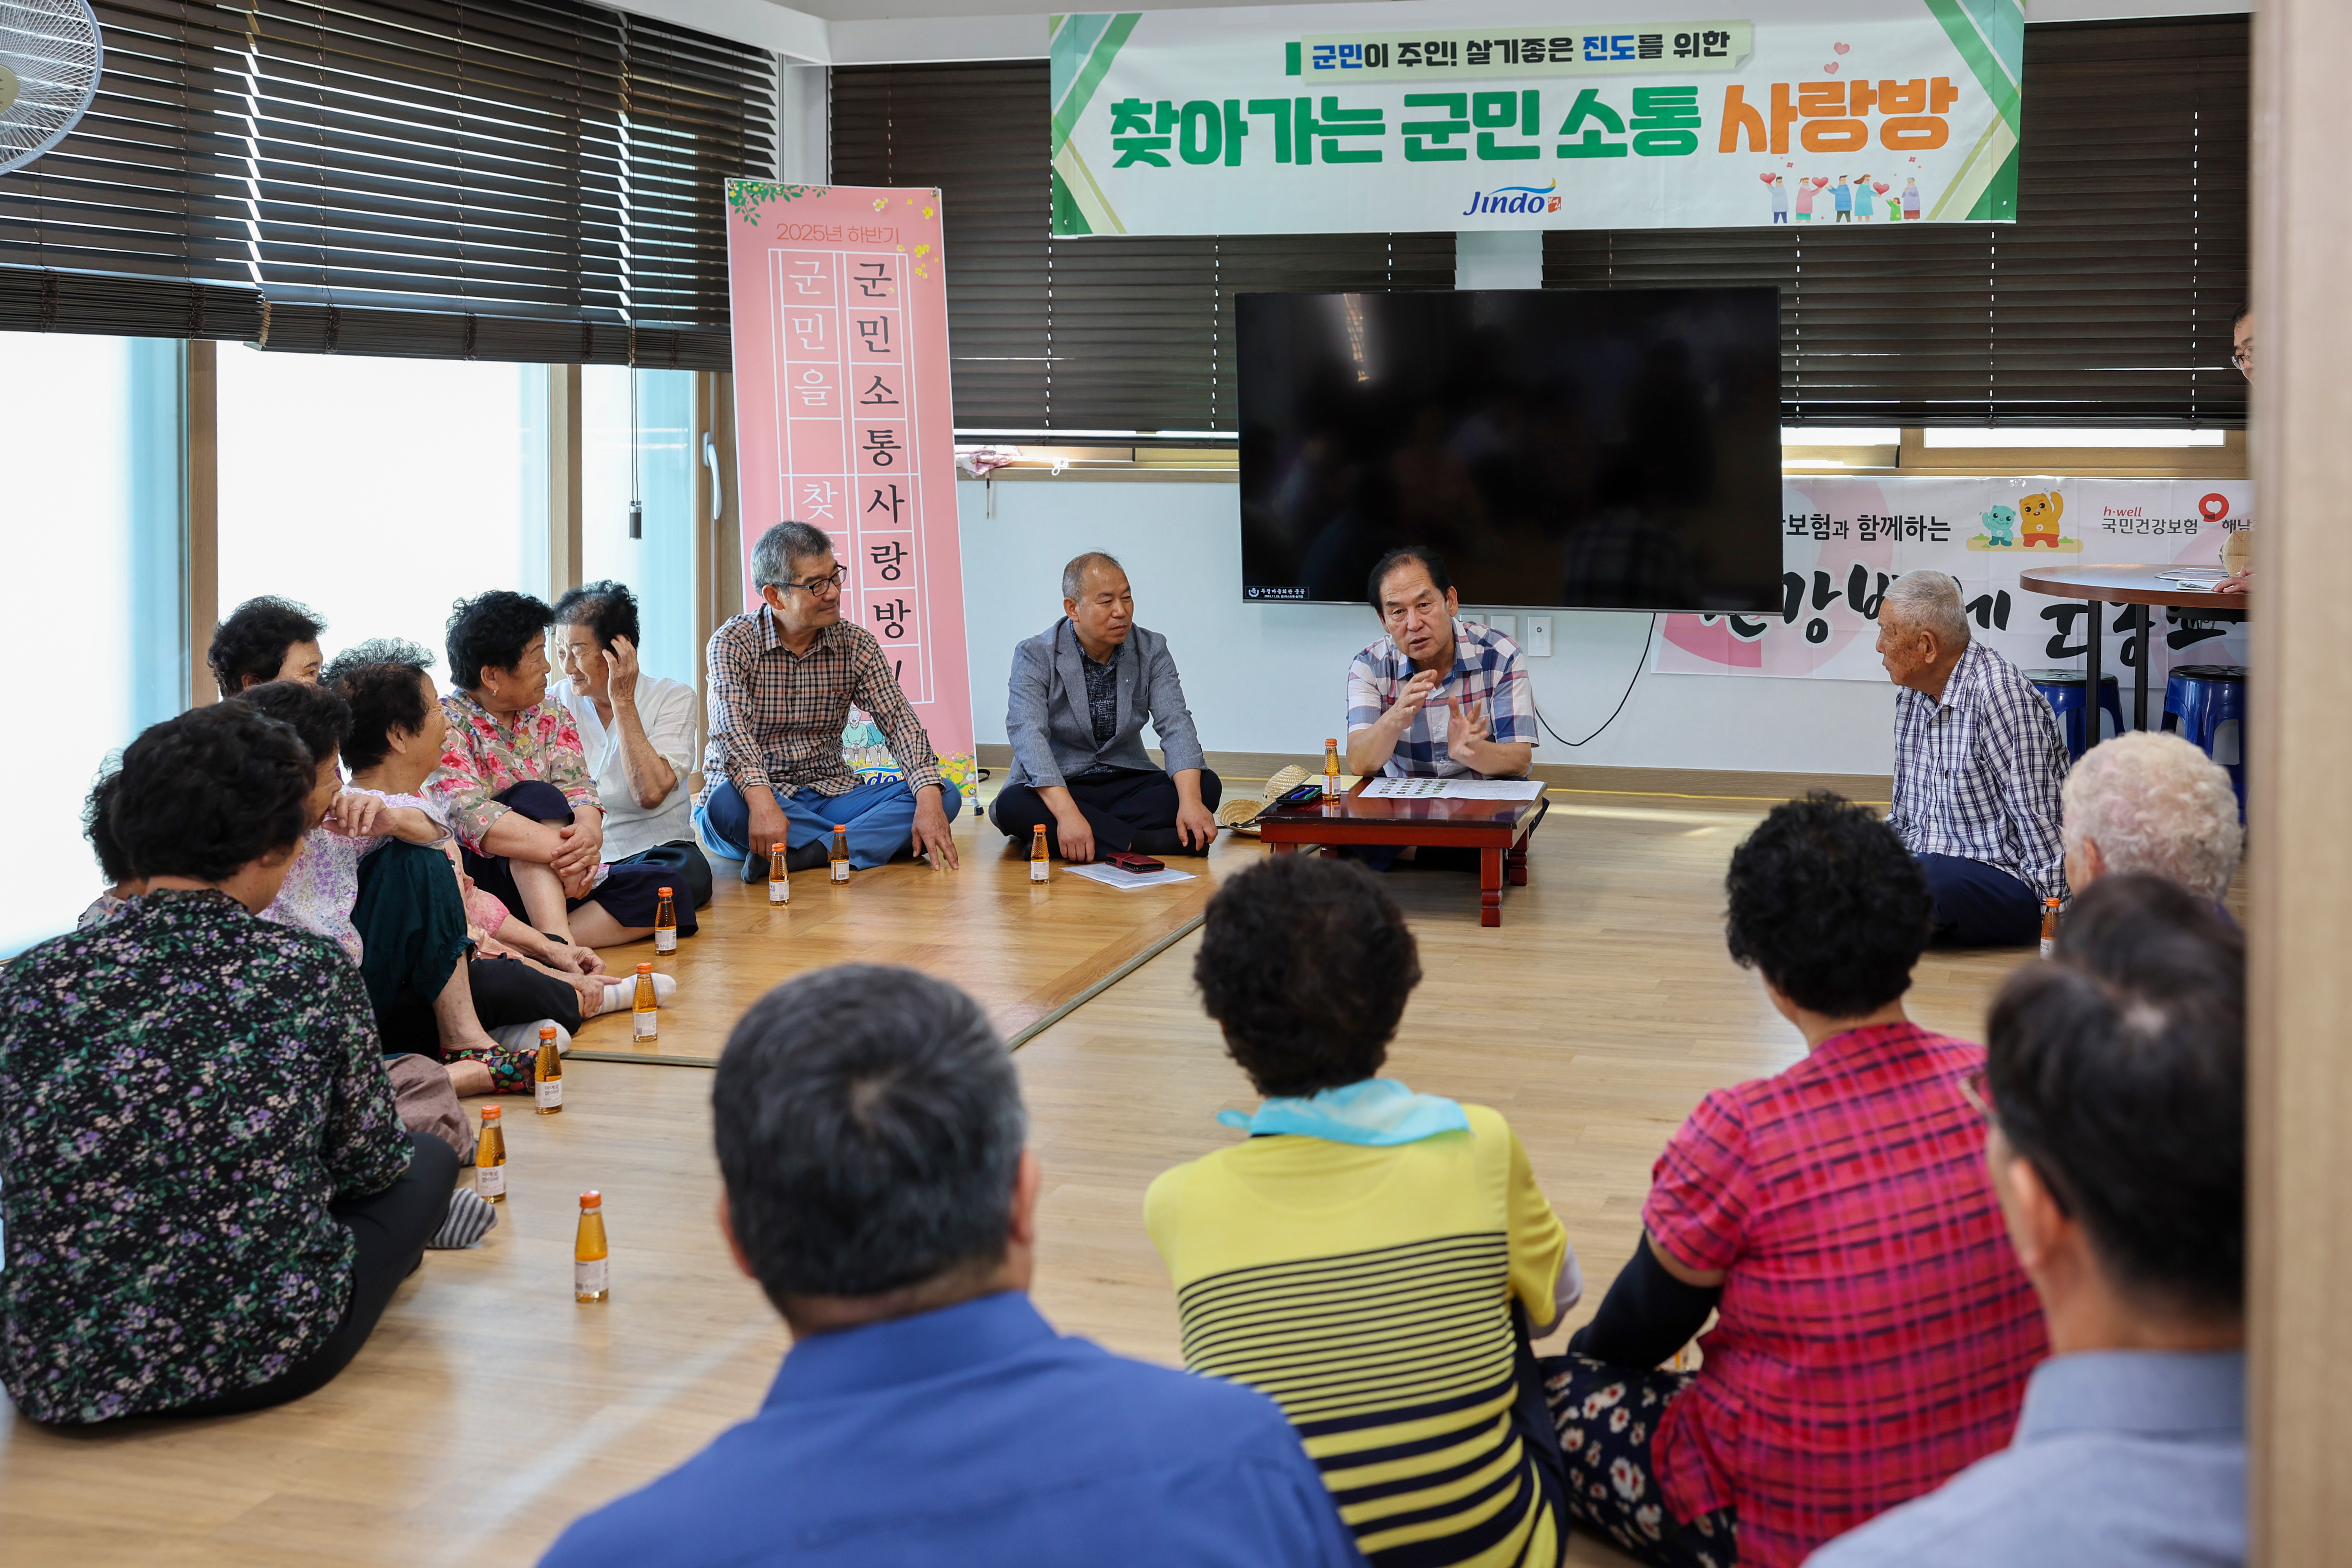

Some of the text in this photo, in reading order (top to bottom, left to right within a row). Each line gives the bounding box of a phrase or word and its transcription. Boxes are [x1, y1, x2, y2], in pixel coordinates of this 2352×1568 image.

[1312, 30, 1730, 69] 군민이 주인! 살기좋은 진도를 위한
[1110, 77, 1959, 168] 찾아가는 군민 소통 사랑방
[1463, 191, 1545, 216] Jindo
[776, 223, 900, 244] 2025년 하반기
[789, 261, 833, 406] 군민을
[1782, 514, 1951, 542] 보험과 함께하는
[2102, 518, 2198, 535] 국민건강보험
